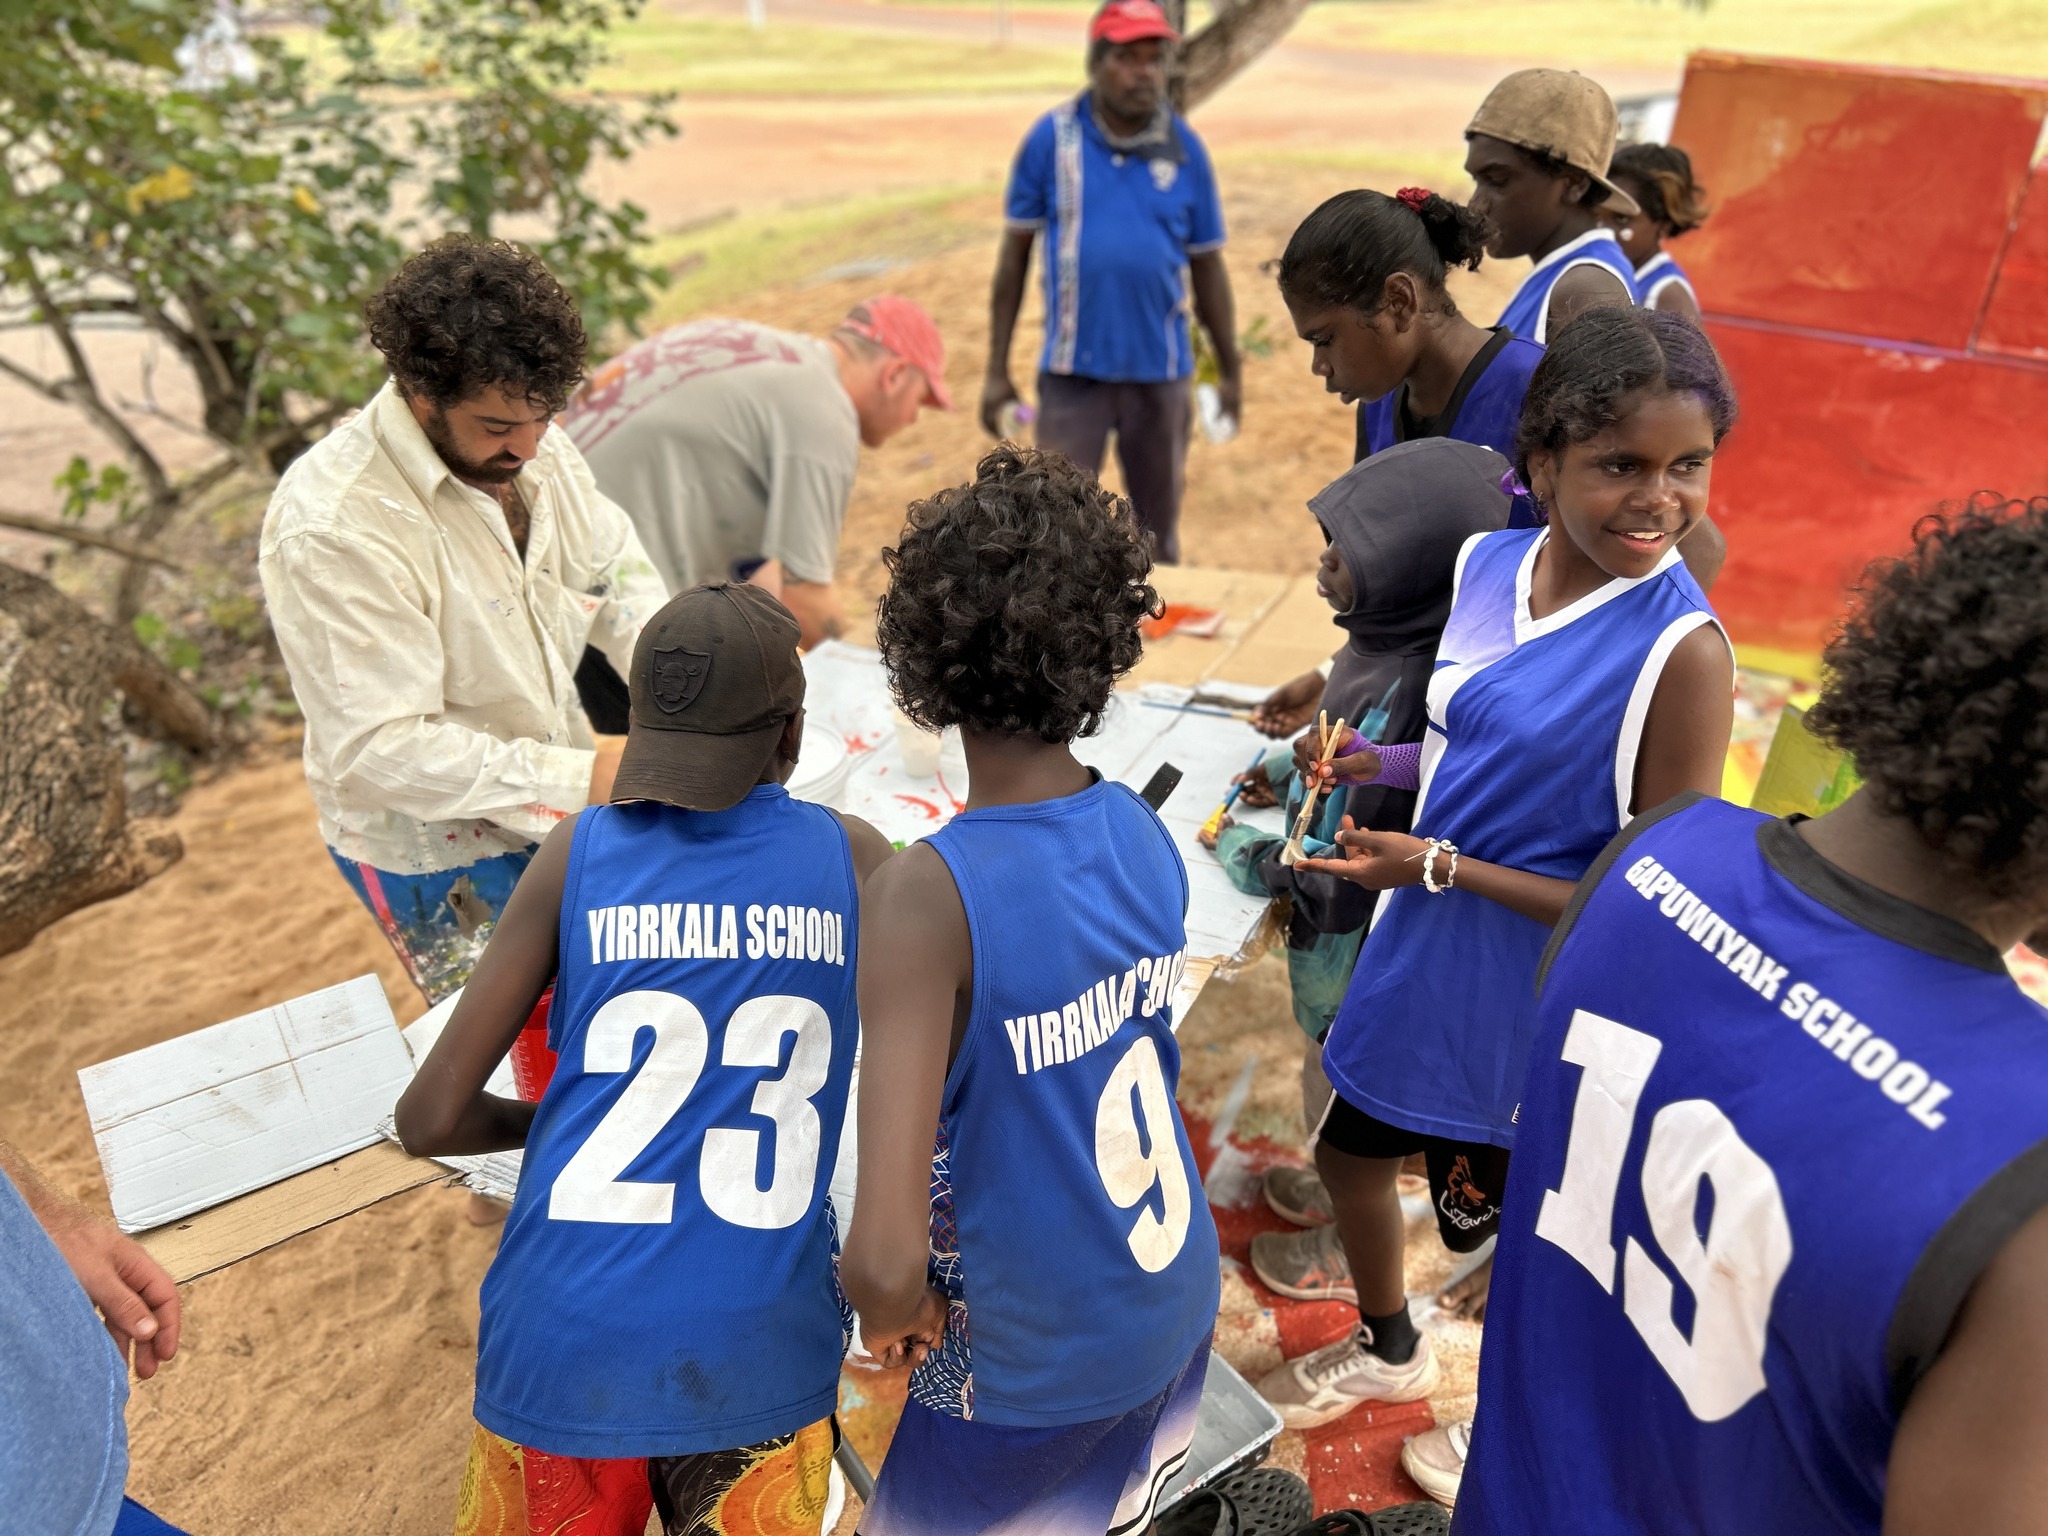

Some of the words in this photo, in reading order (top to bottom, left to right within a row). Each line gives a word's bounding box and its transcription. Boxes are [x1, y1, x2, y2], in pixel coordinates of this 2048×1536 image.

[588, 903, 739, 965] YIRRKALA
[746, 904, 845, 967] SCHOOL
[1003, 963, 1136, 1075] YIRRKALA
[1624, 855, 1790, 1002] GAPUWIYAK
[1779, 981, 1954, 1131] SCHOOL
[547, 989, 832, 1230] 23
[1094, 1035, 1192, 1273] 9
[1534, 1008, 1793, 1423] 19
